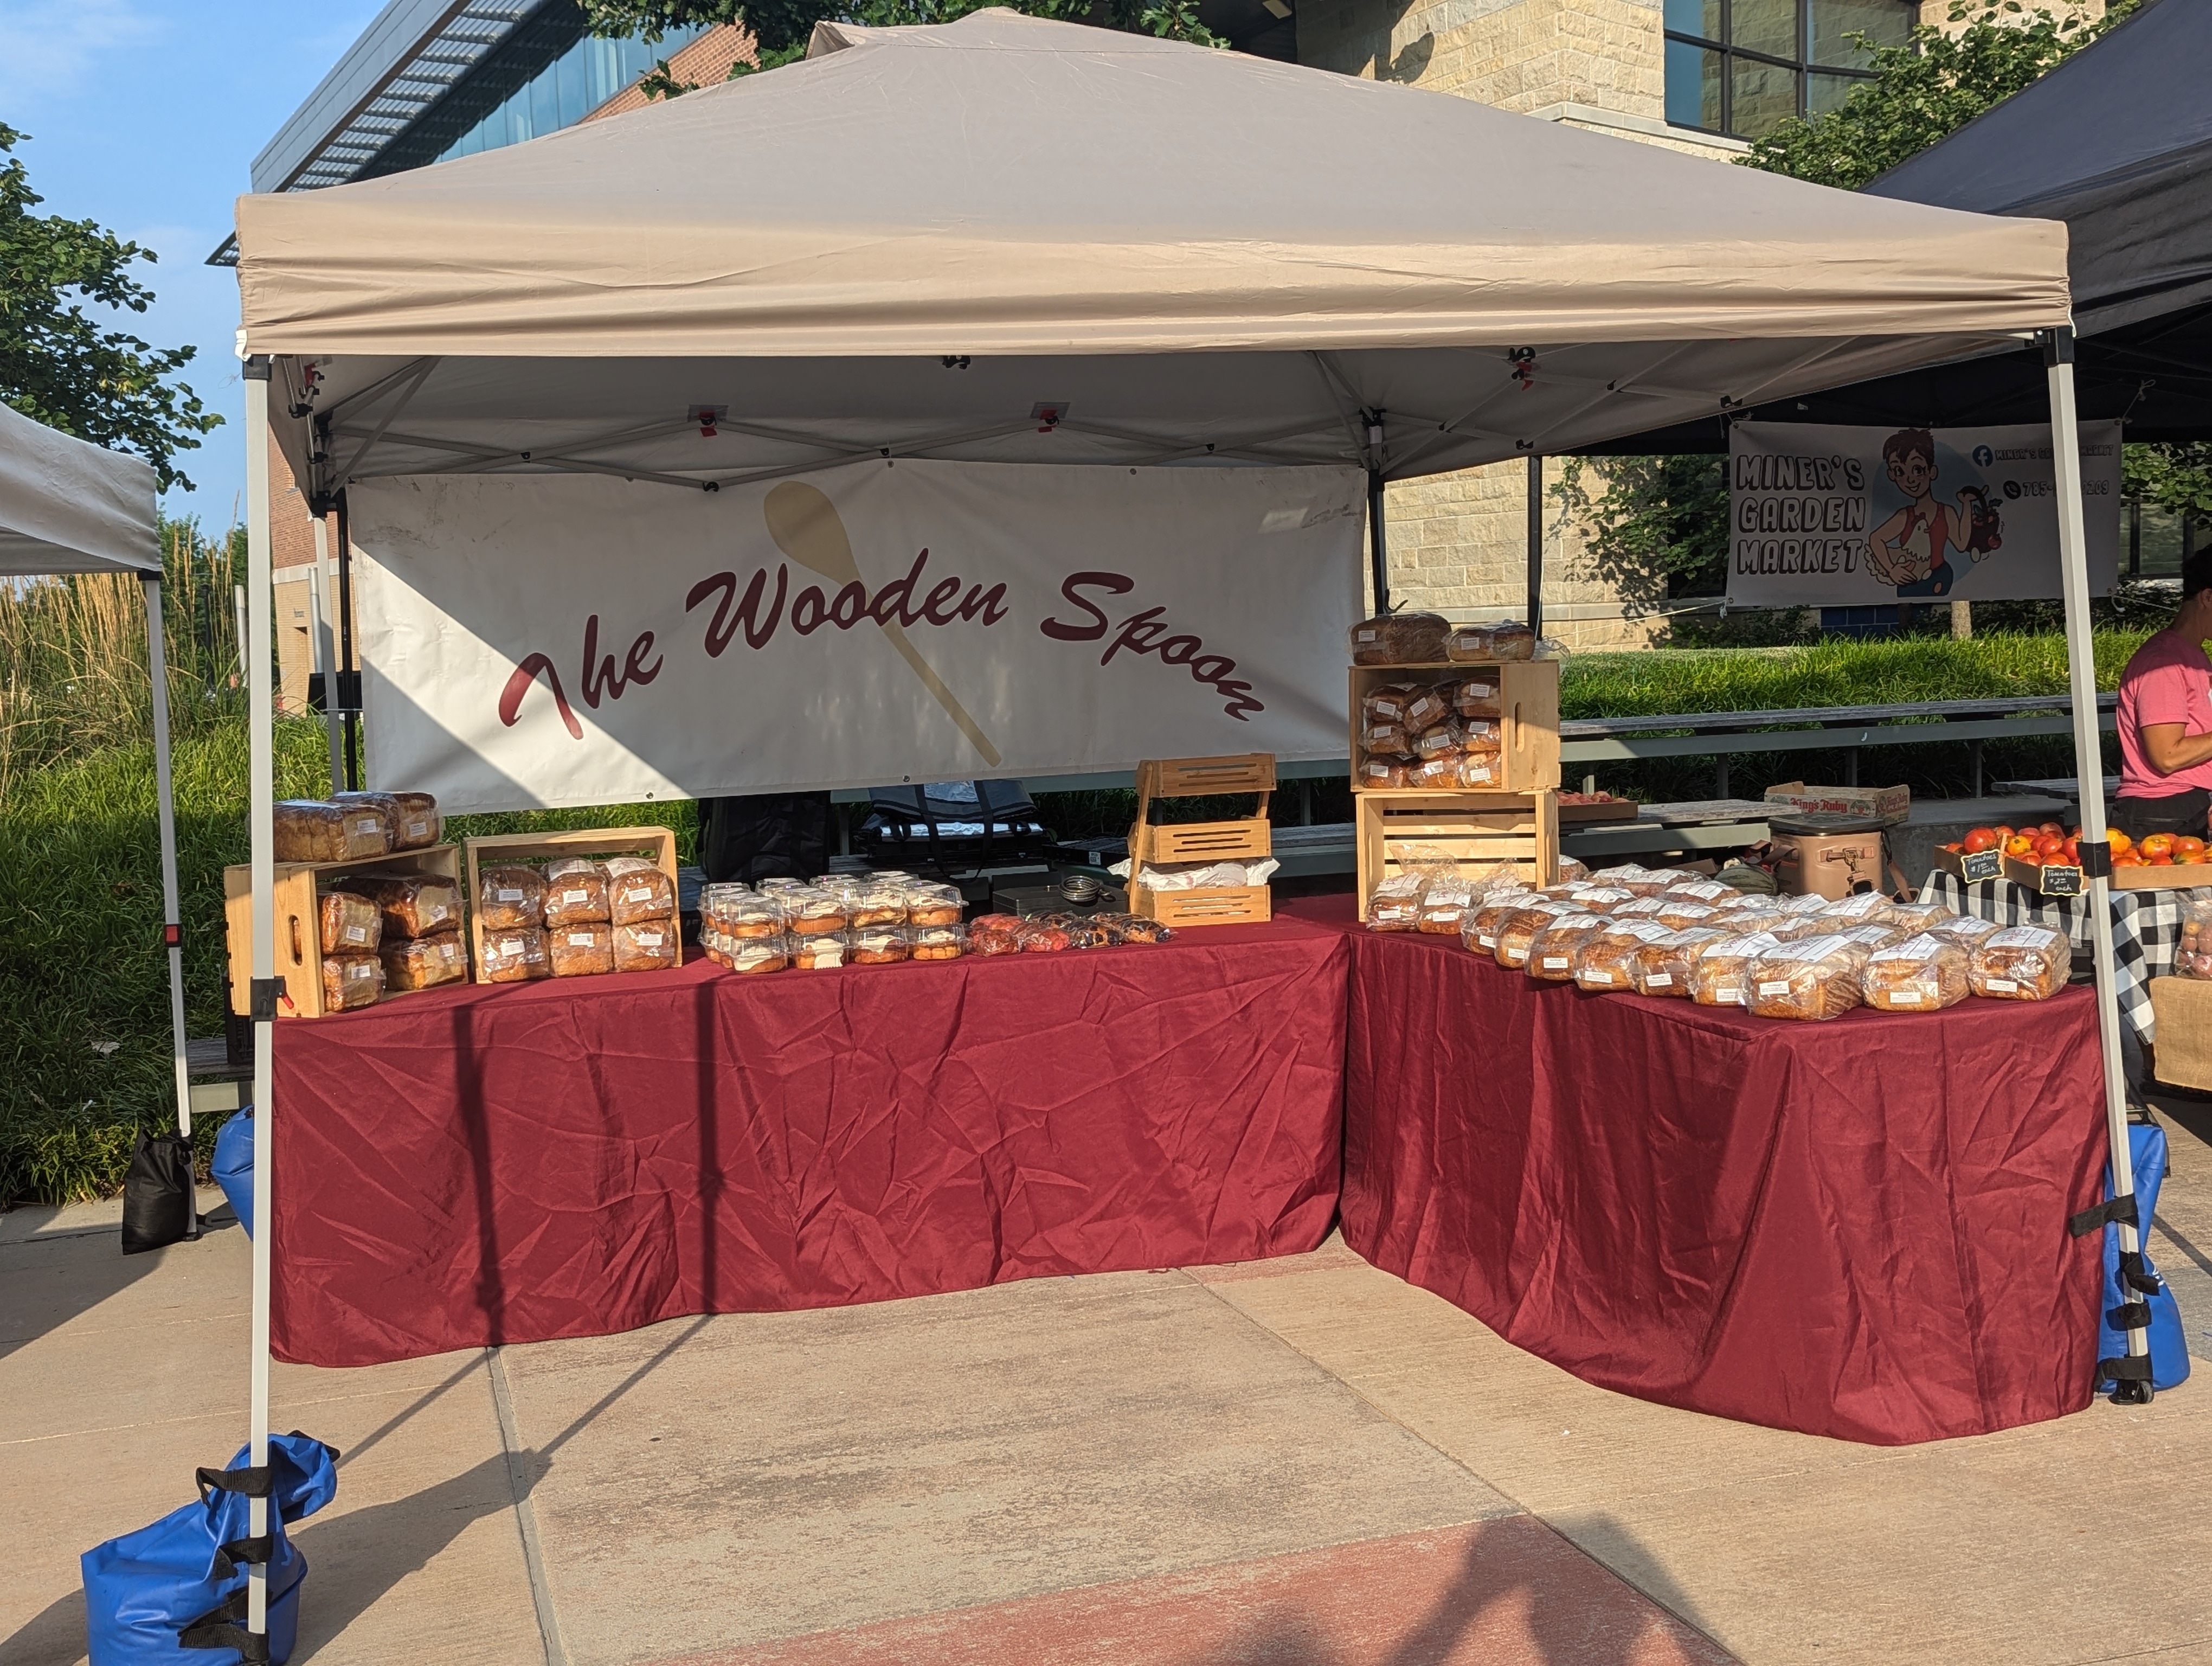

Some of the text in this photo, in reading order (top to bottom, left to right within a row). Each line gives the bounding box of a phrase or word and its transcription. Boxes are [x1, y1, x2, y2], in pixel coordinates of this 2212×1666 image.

[1995, 448, 2037, 460] MINER'S
[1737, 454, 1864, 490] MINER'S
[1738, 497, 1866, 533] GARDEN
[1737, 539, 1863, 575] MARKET
[498, 547, 1265, 740] The Wooden Spoon
[1790, 797, 1848, 813] King's Ruby
[1966, 853, 1997, 865] Tomatoes
[1981, 866, 1996, 875] each
[2055, 883, 2073, 892] each
